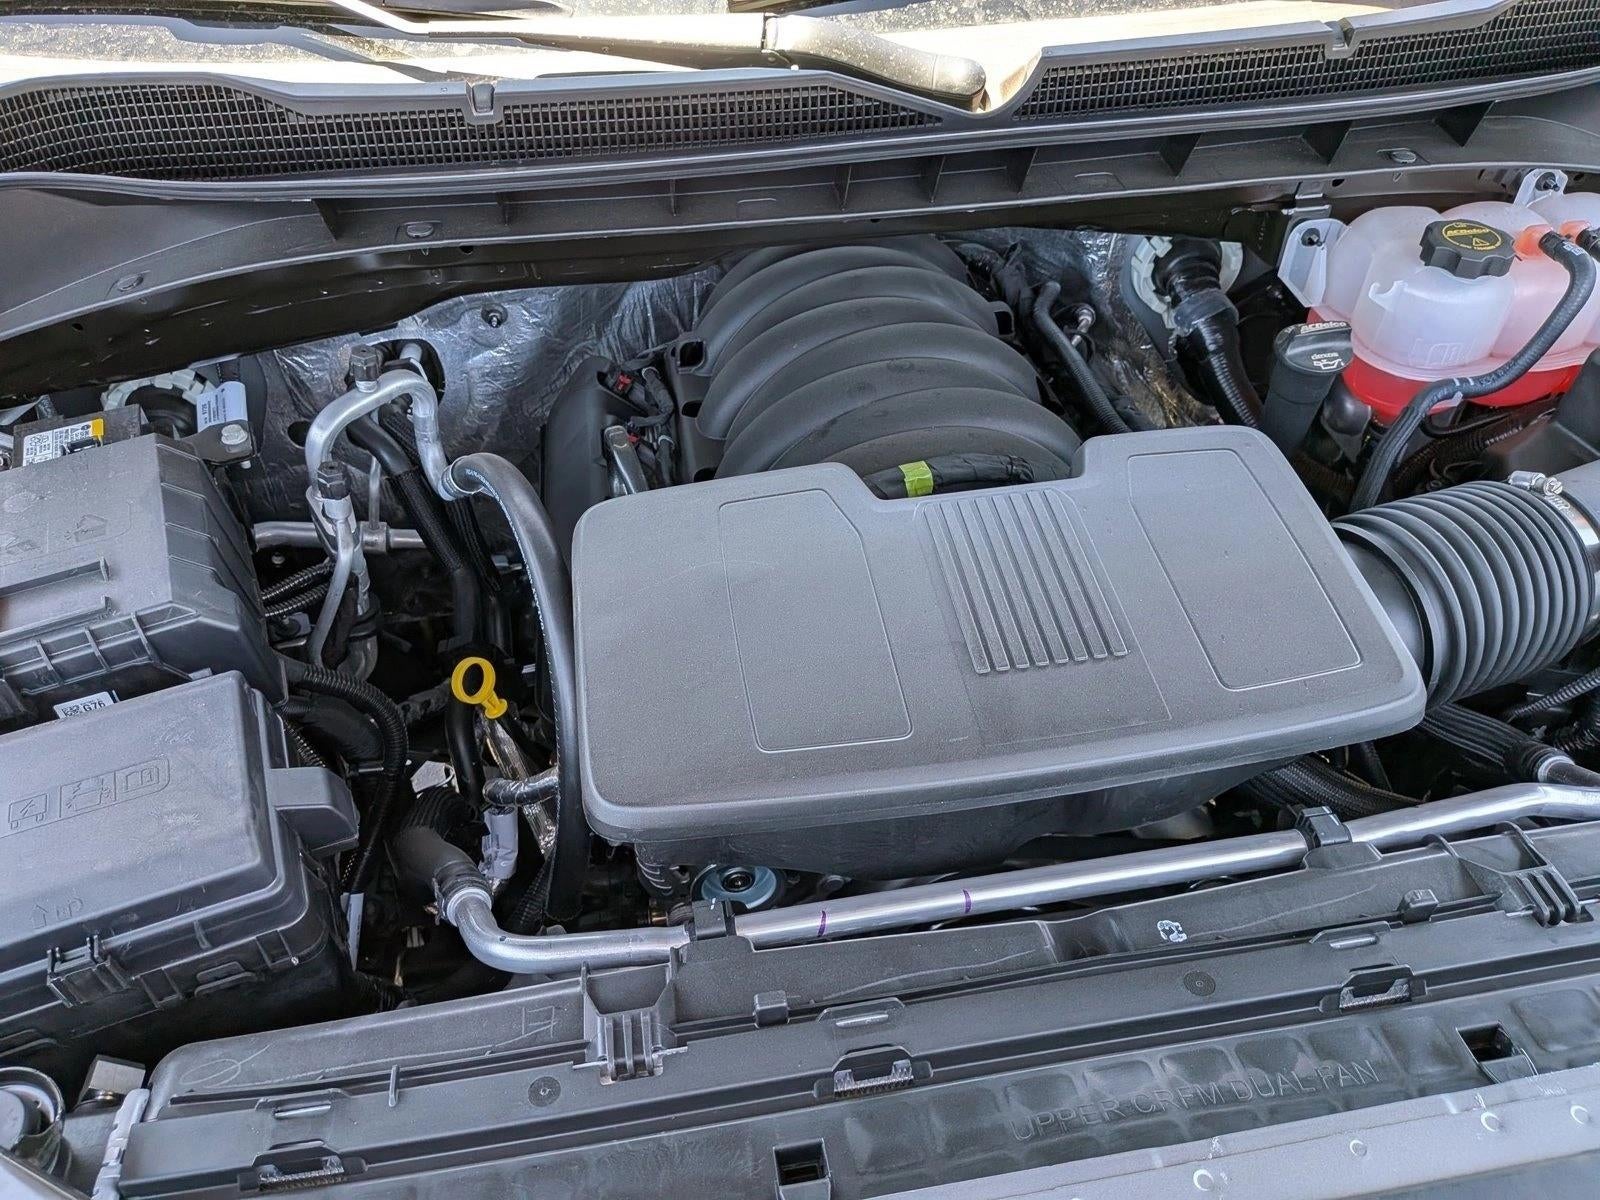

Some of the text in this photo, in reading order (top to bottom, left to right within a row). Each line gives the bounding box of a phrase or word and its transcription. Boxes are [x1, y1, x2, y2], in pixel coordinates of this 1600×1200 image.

[1300, 321, 1347, 334] ACDelco
[83, 700, 105, 712] G76
[1010, 1059, 1382, 1142] UPPER CRFM DUAL FAN
